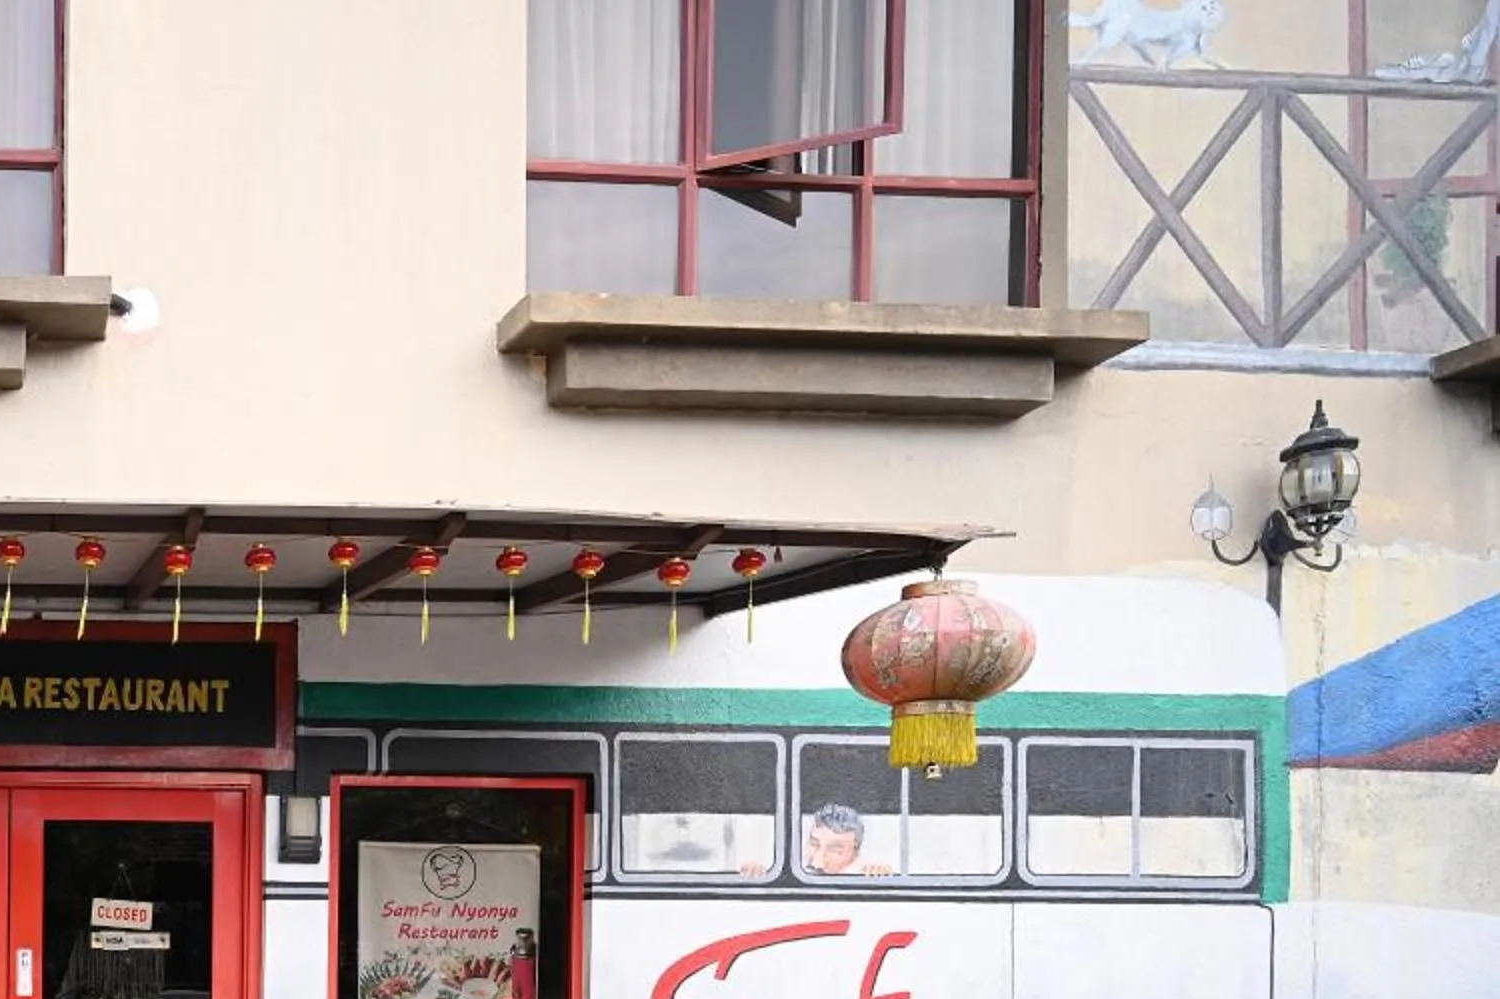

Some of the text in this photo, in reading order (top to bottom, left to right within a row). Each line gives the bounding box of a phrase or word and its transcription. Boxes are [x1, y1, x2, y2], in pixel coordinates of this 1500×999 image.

[23, 677, 230, 713] RESTAURANT
[97, 905, 148, 923] CLOSED
[381, 900, 519, 922] SamFu Nyonya
[398, 923, 499, 940] Restaurant
